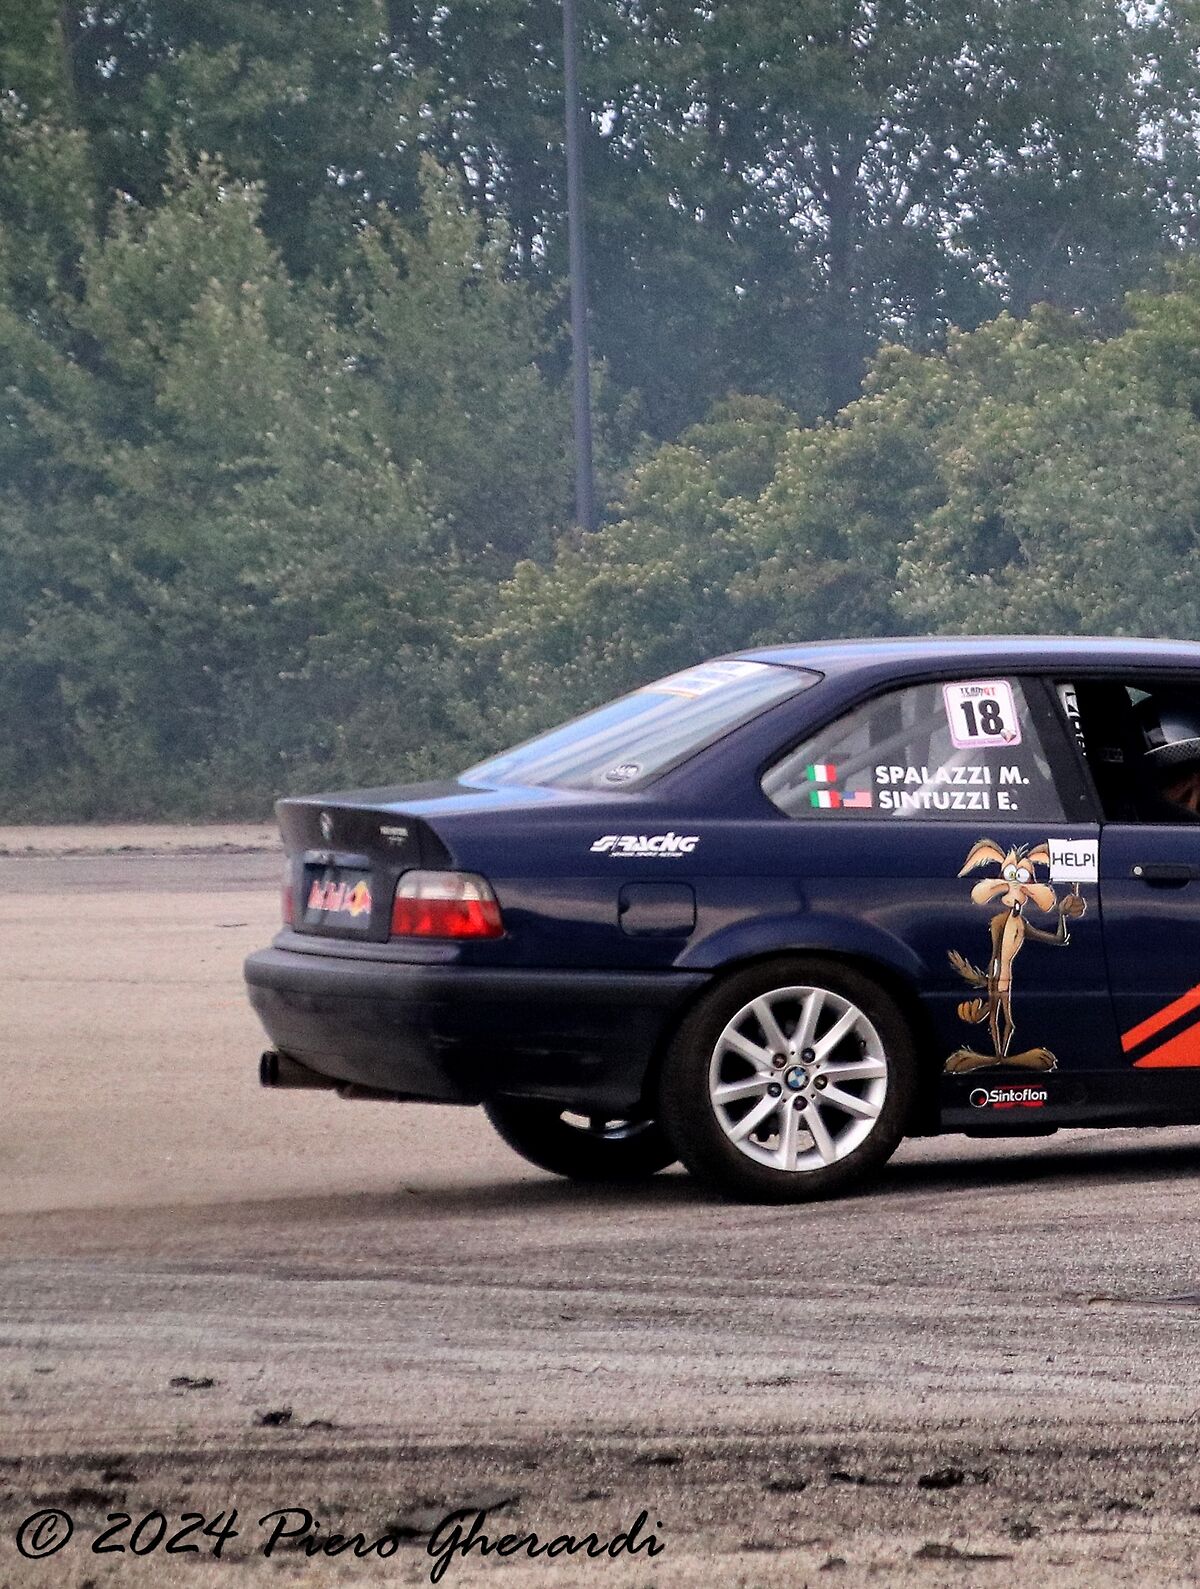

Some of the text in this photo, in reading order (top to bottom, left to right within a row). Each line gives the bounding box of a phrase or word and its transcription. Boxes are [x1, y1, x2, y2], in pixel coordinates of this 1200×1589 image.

[960, 699, 1004, 737] 18
[875, 765, 1030, 785] SPALAZZI M.
[879, 791, 1018, 811] SINTUZZI E.
[1052, 852, 1096, 868] HELP!
[988, 1089, 1048, 1102] Sintoflon
